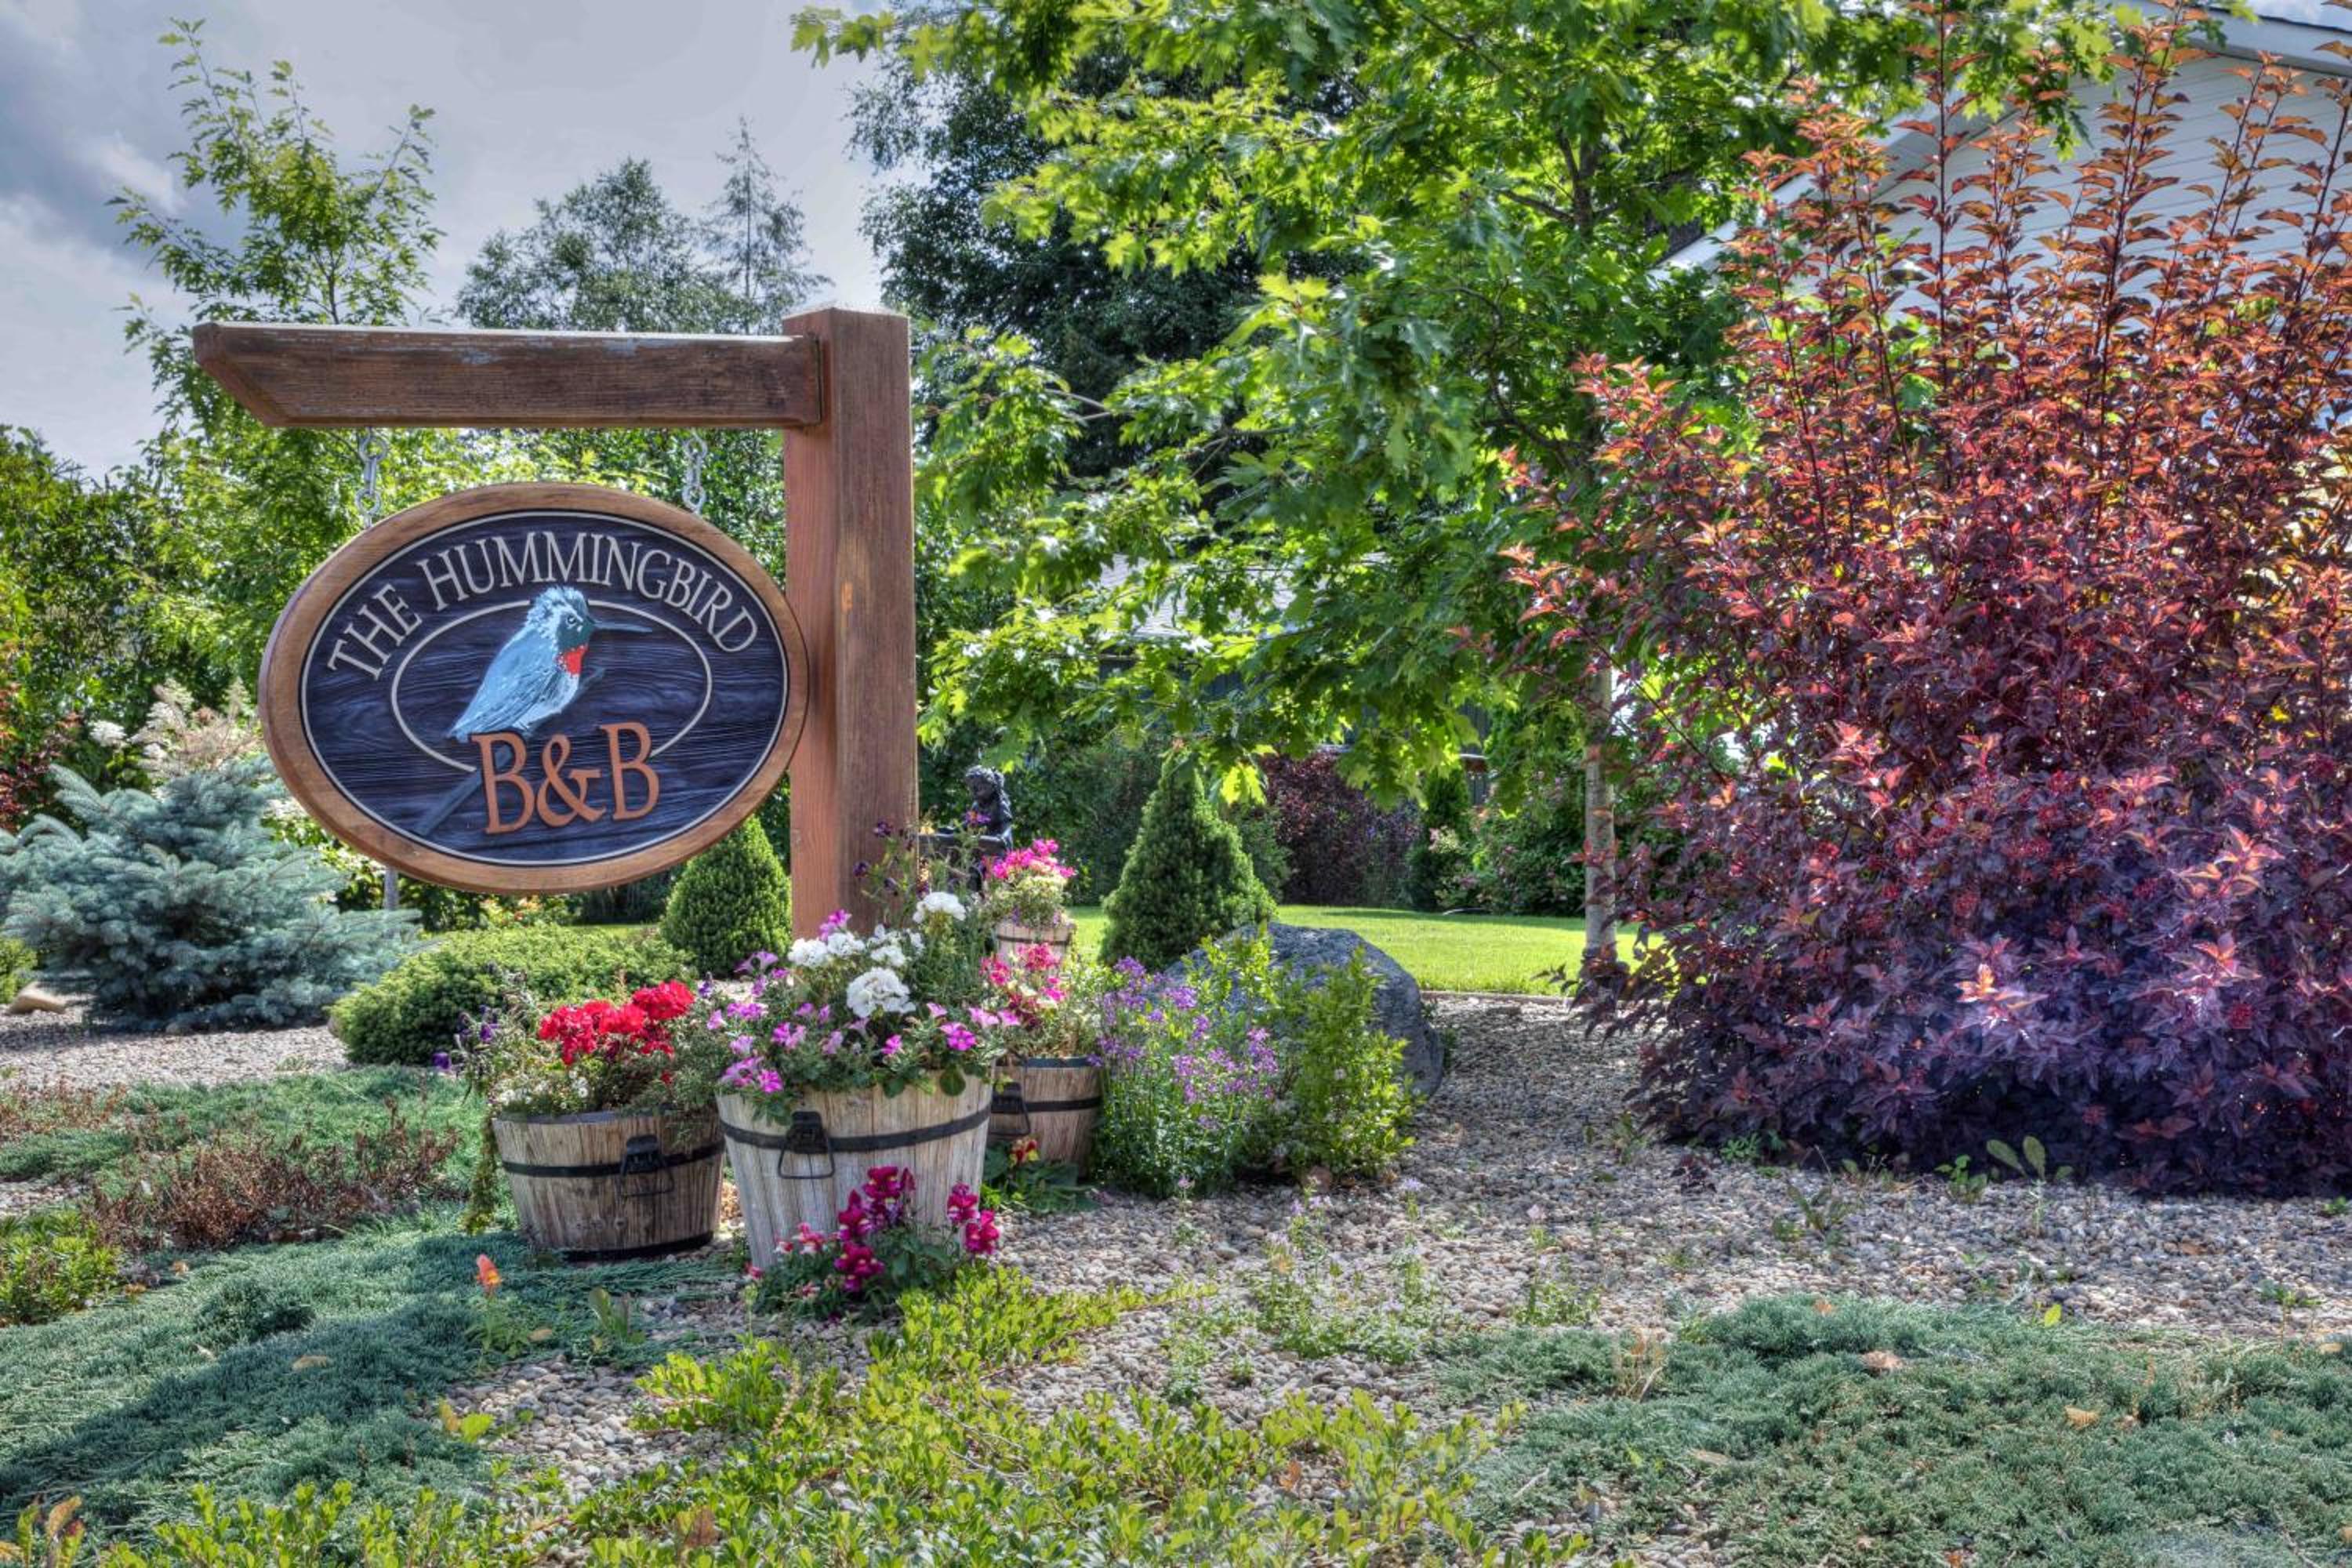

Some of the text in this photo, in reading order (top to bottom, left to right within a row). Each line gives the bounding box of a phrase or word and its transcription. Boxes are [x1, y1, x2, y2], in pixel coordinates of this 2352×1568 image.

[327, 532, 757, 681] THE HUMMINGBIRD
[472, 722, 660, 834] B&B
